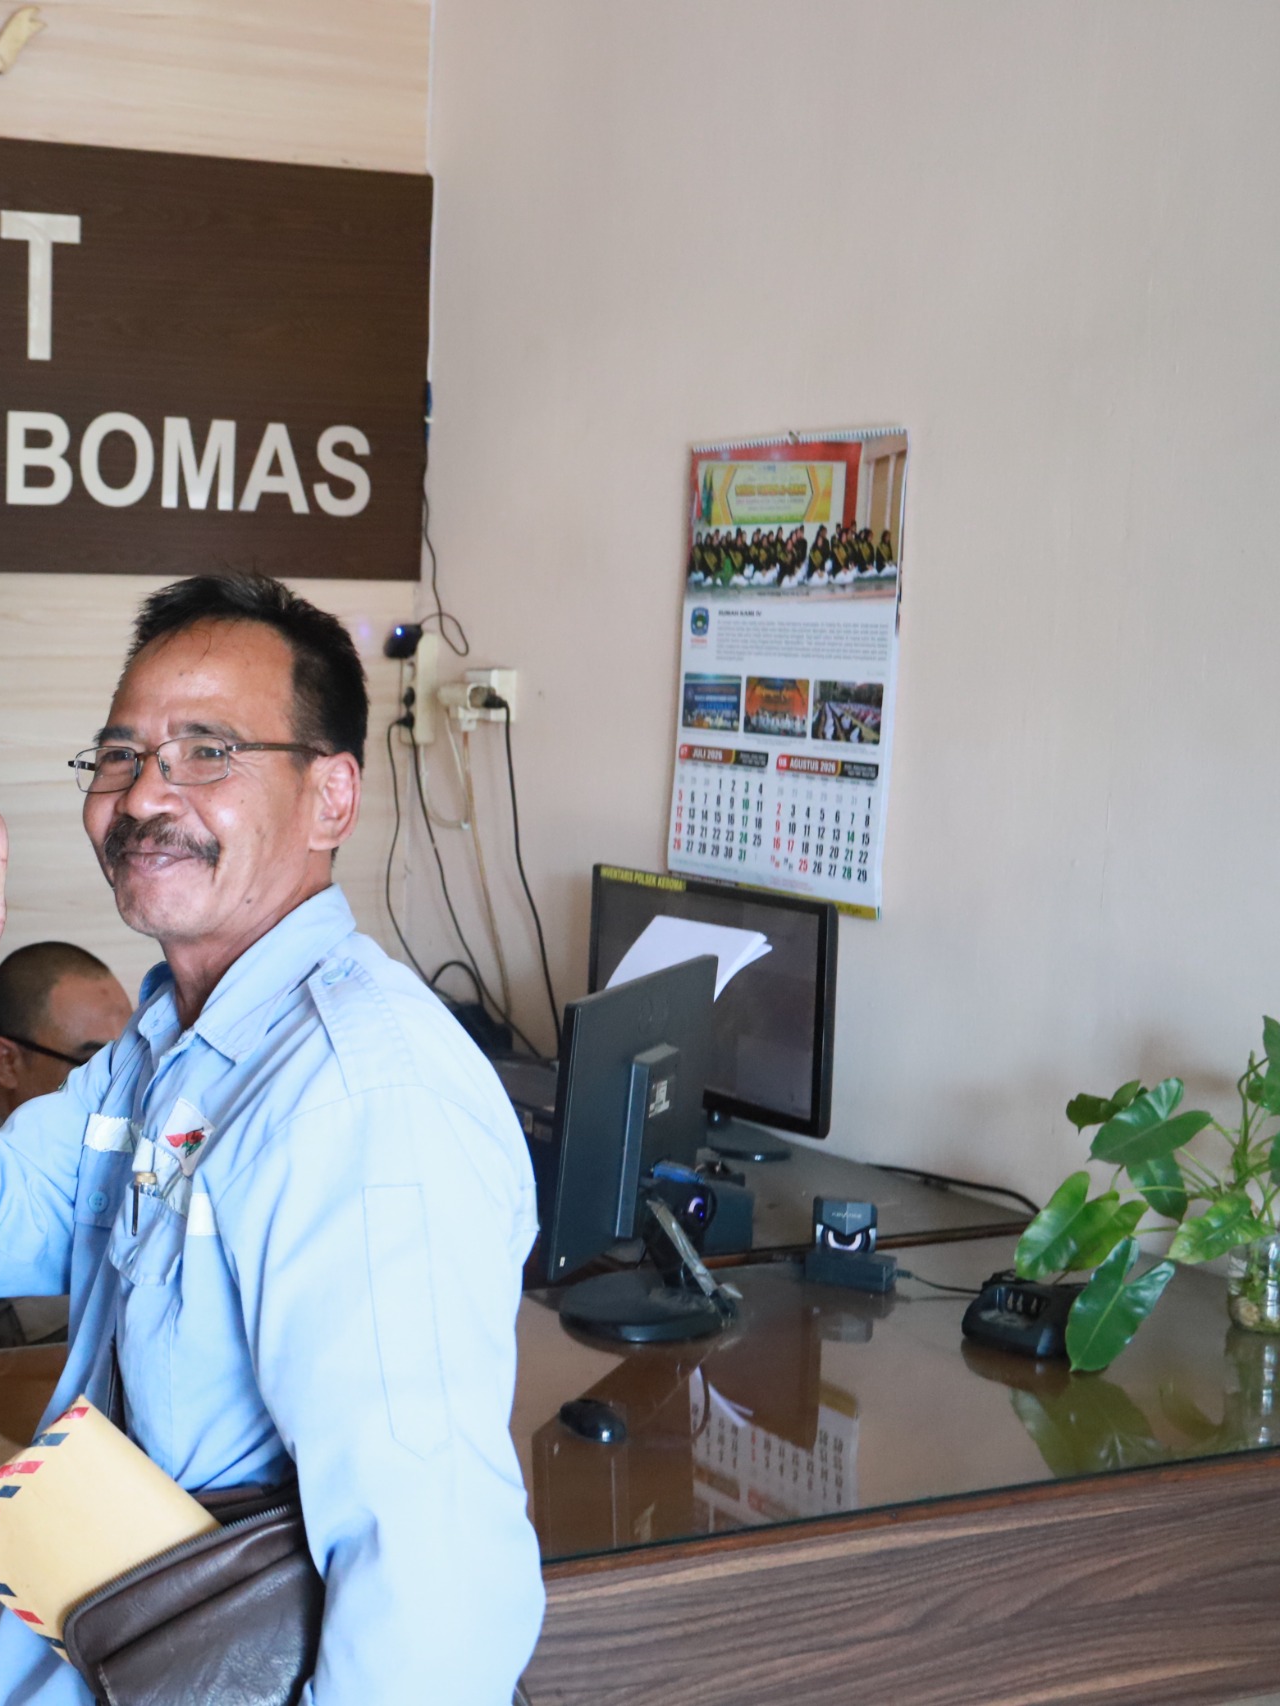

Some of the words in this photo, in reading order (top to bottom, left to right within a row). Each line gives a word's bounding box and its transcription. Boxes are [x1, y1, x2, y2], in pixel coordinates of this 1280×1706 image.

[692, 749, 706, 759] JULI
[790, 758, 819, 772] AGUSTUS
[718, 778, 722, 790] 1
[731, 780, 735, 792] 2
[745, 781, 749, 793] 3
[758, 783, 763, 795] 4
[677, 806, 683, 818] 12
[689, 808, 695, 819] 13
[702, 810, 708, 821] 14
[715, 811, 721, 823] 15
[728, 813, 734, 825] 16
[742, 815, 748, 827] 17
[755, 817, 762, 829] 18
[777, 803, 781, 816] 2
[791, 805, 795, 817] 3
[806, 807, 810, 819] 4
[820, 809, 824, 821] 5
[835, 811, 840, 823] 6
[851, 813, 854, 825] 7
[865, 815, 869, 827] 8
[675, 822, 681, 834] 19
[687, 824, 694, 836] 20
[700, 826, 707, 838] 21
[713, 828, 721, 840] 22
[726, 830, 734, 842] 23
[739, 832, 747, 844] 24
[753, 834, 761, 846] 25
[776, 820, 780, 832] 9
[789, 823, 796, 835] 10
[804, 824, 810, 837] 11
[818, 826, 825, 839] 12
[833, 829, 840, 841] 13
[848, 830, 854, 843] 14
[862, 833, 869, 846] 15
[673, 838, 681, 850] 26
[686, 840, 694, 852] 27
[698, 842, 706, 854] 28
[711, 844, 719, 857] 29
[724, 846, 732, 859] 30
[738, 849, 746, 862] 31
[773, 837, 780, 850] 16
[788, 840, 794, 853] 17
[802, 842, 809, 855] 18
[816, 845, 823, 857] 19
[830, 847, 839, 859] 20
[845, 849, 853, 862] 21
[859, 851, 868, 864] 22
[799, 860, 808, 872] 25
[813, 862, 822, 874] 26
[828, 864, 837, 877] 27
[842, 867, 852, 880] 28
[858, 869, 867, 883] 29
